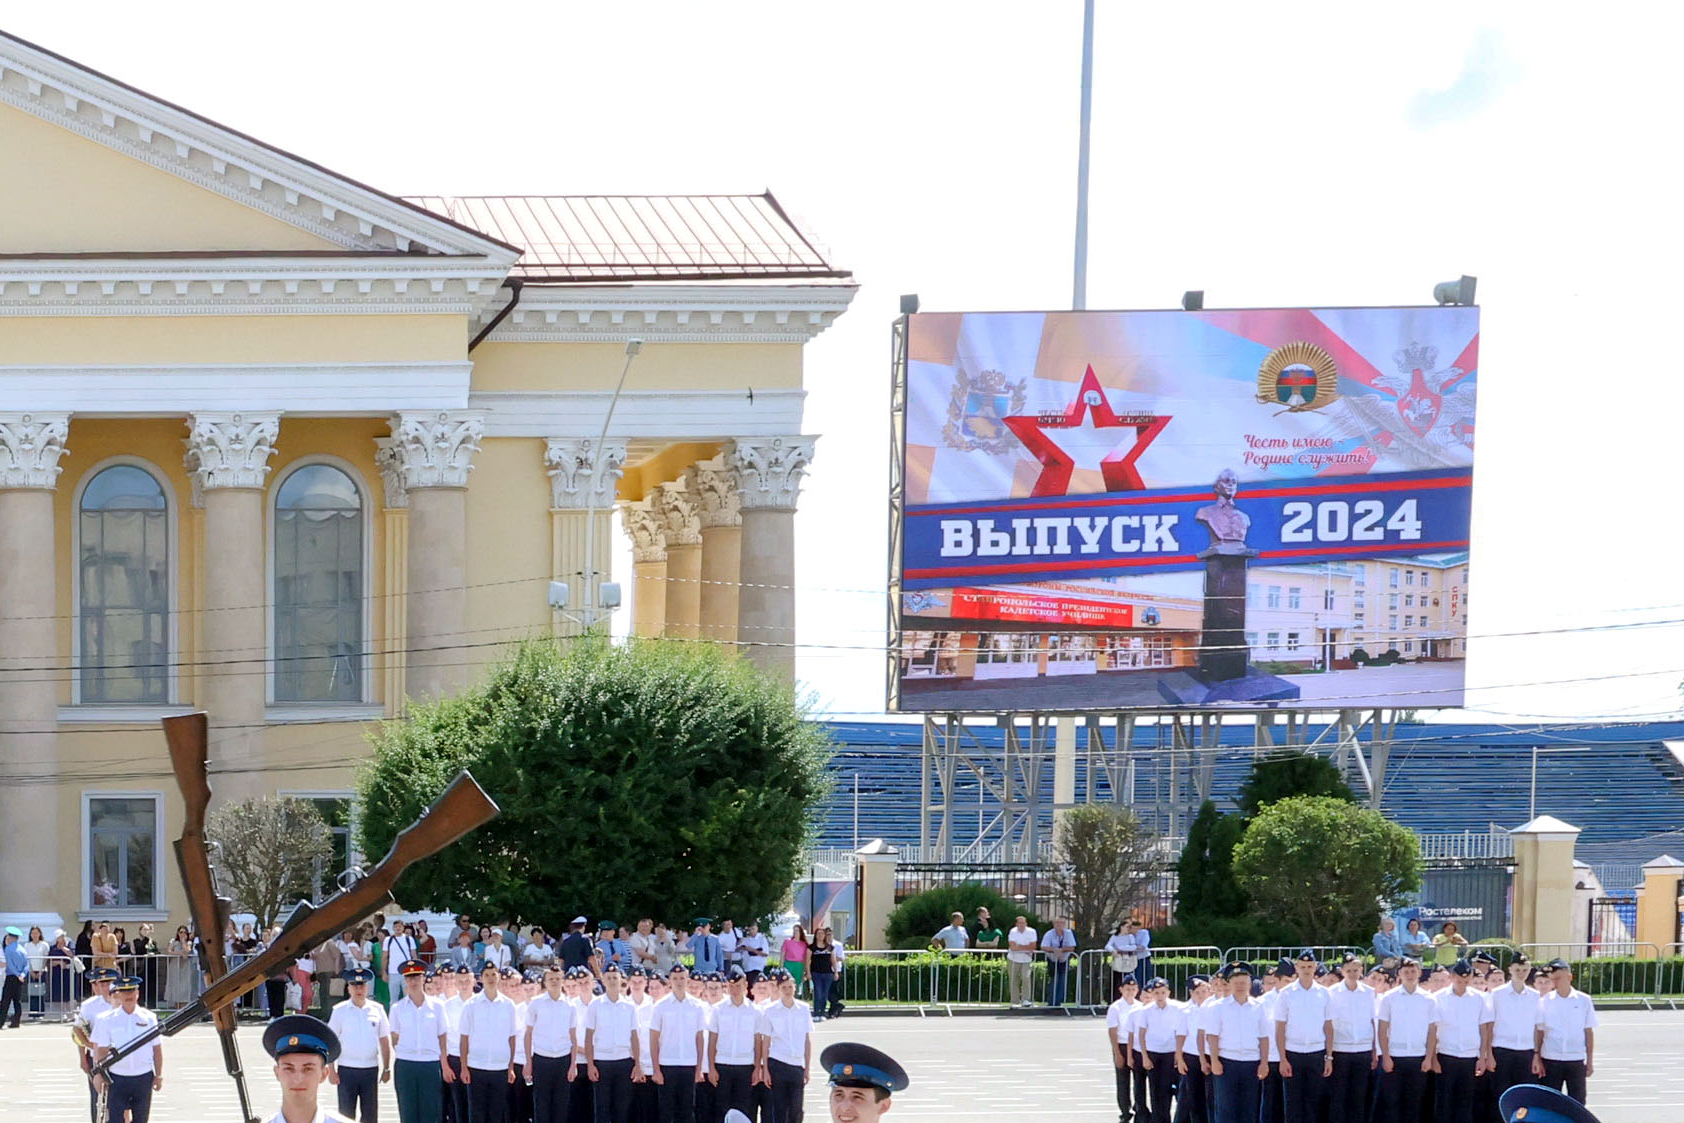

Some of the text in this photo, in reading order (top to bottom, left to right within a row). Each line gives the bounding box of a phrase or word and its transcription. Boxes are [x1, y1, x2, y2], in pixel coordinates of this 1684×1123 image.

[1244, 434, 1289, 448] Честь
[1292, 437, 1333, 448] имею
[1243, 449, 1370, 470] Родине служить!
[940, 499, 1422, 557] ВЫПУСК 2024
[1418, 906, 1483, 917] Ростелеком
